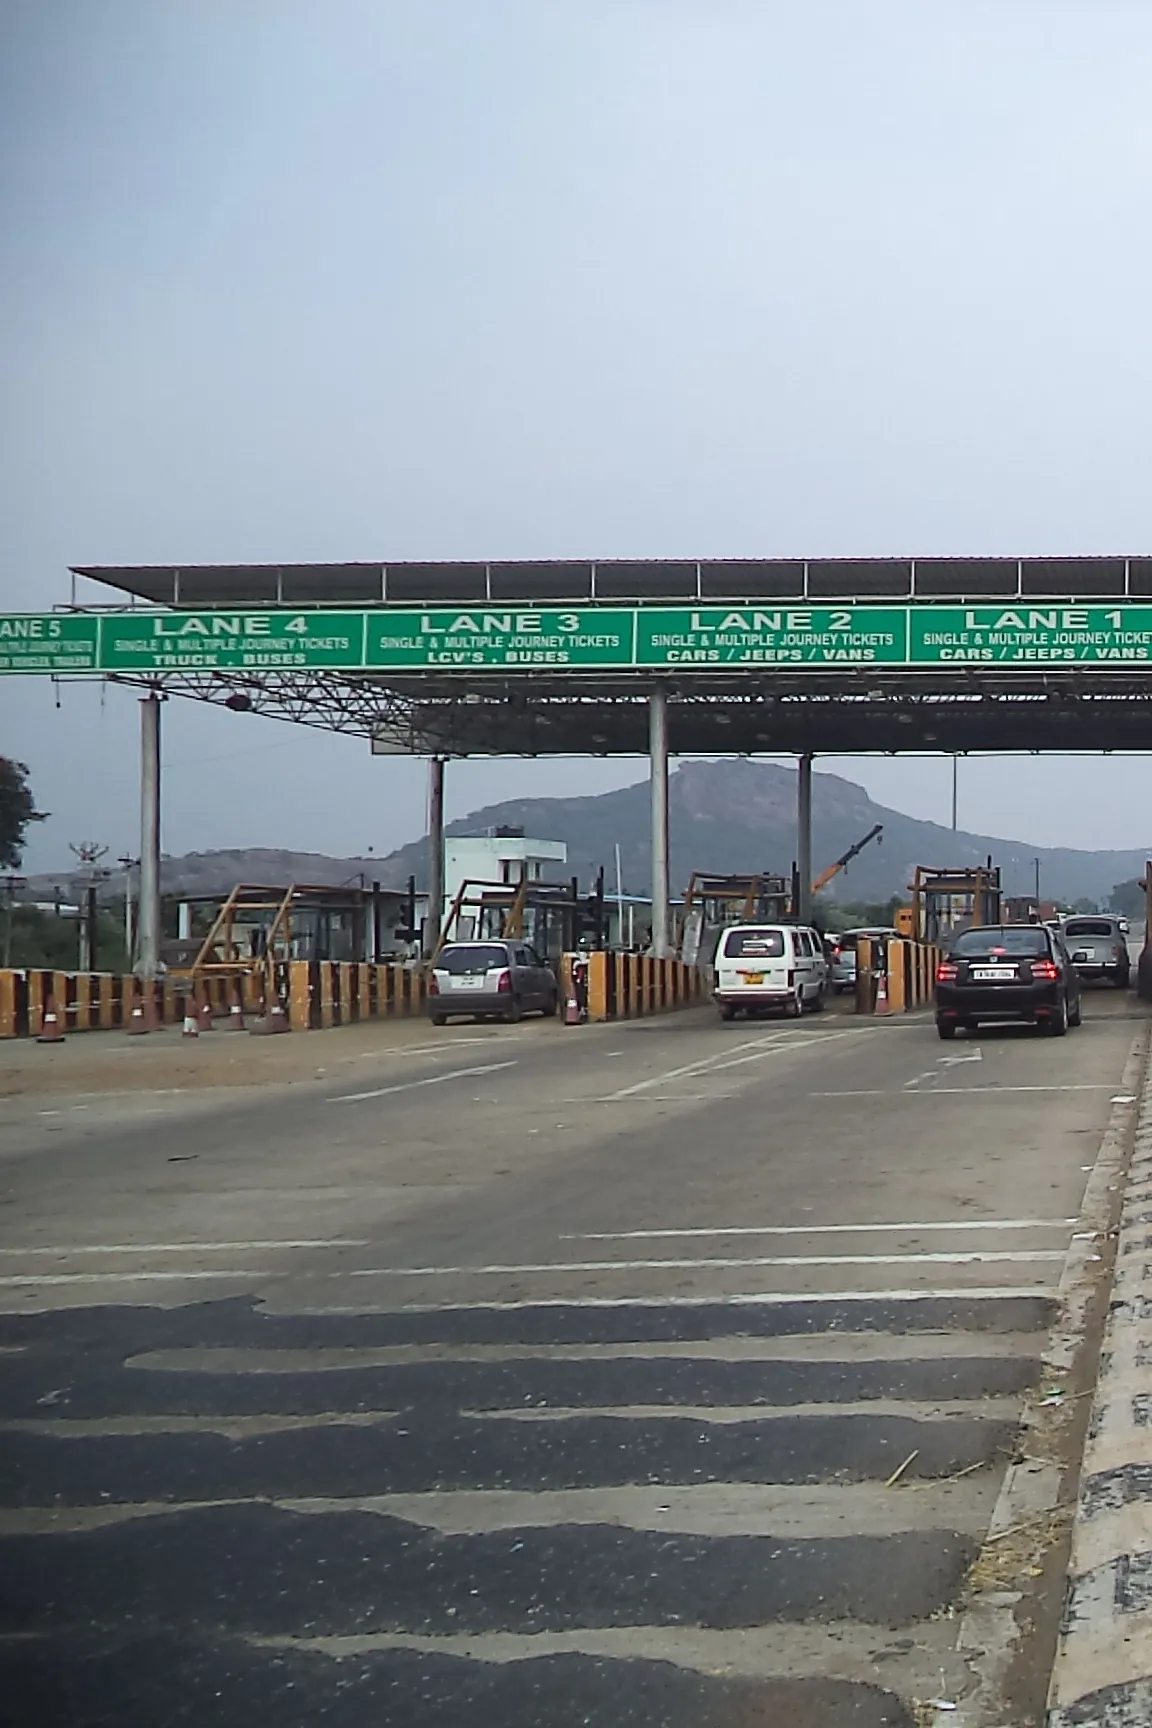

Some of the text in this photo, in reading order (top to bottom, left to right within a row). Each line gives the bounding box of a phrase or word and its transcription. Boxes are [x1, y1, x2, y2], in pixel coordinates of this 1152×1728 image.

[154, 616, 308, 635] LANE 4
[421, 614, 580, 633] LANE 3
[691, 612, 852, 631] LANE 2
[965, 611, 1123, 629] LANE 1
[48, 620, 61, 637] 5
[114, 640, 157, 651] SINGLE
[178, 639, 237, 650] MULTIPLE
[239, 638, 296, 650] JOURNEY
[298, 637, 349, 649] TICKETS
[380, 637, 424, 649] SINGLE
[444, 636, 503, 648] MULTIPLE
[508, 636, 567, 648] JOURNEY
[568, 635, 619, 647] TICKETS
[651, 633, 894, 646] SINGLE & MULTIPLE JOURNEY TICKETS
[923, 633, 968, 645] SINGLE
[974, 633, 983, 645] &
[989, 633, 1048, 645] MULTIPLE
[1052, 632, 1111, 645] JOURNEY
[153, 655, 218, 665] TRUCK
[243, 653, 306, 665] BUSES
[505, 651, 569, 662] BUSES
[667, 649, 720, 661] CARS
[739, 649, 802, 661] JEEPS
[822, 649, 875, 661] VANS
[940, 648, 993, 660] CARS
[1012, 648, 1075, 660] JEEPS
[1095, 648, 1148, 660] VANS
